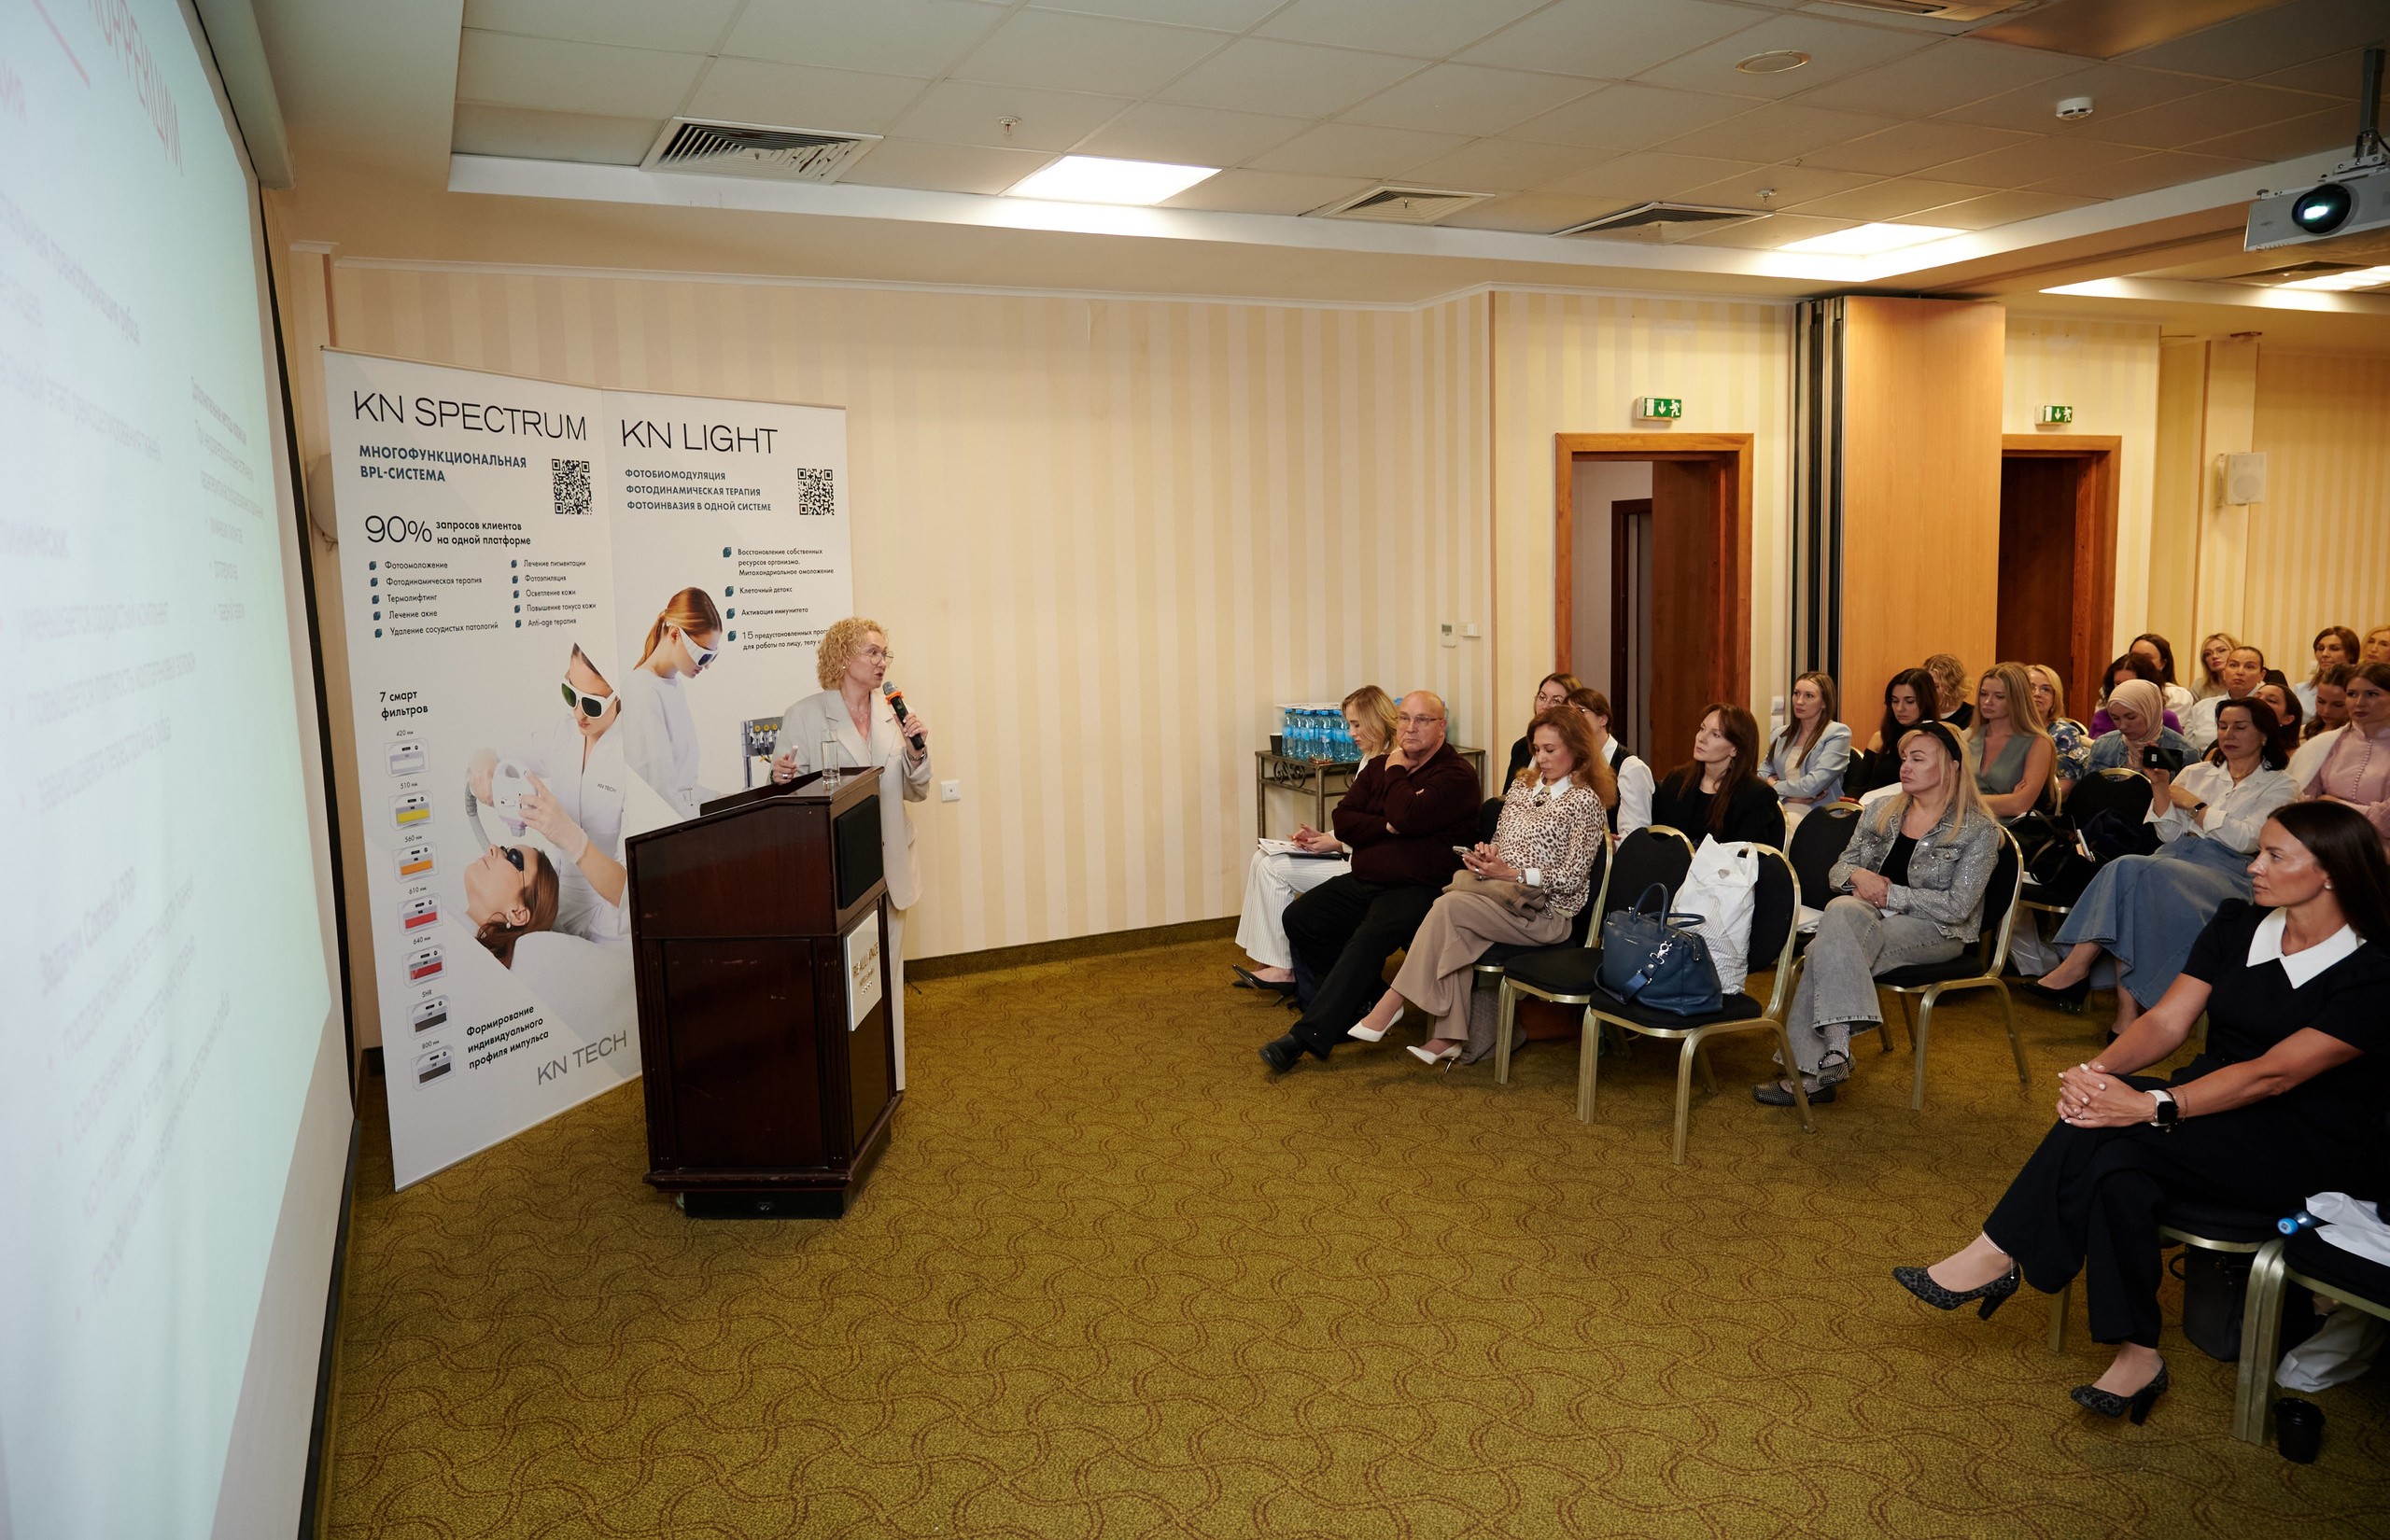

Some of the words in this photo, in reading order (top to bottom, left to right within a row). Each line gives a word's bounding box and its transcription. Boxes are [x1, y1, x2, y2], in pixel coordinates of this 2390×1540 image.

[353, 390, 404, 424] KN
[415, 397, 586, 441] SPECTRUM
[621, 419, 671, 449] KN
[683, 423, 778, 454] LIGHT
[359, 444, 527, 468] МНОГОФУНКЦИОНАЛЬНАЯ
[360, 465, 445, 482] BPL-СИСТЕМА
[625, 469, 725, 481] ФОТОБИОМОДУЛЯЦИЯ
[626, 484, 724, 496] ФОТОДИНАМИЧЕСКАЯ
[725, 487, 761, 496] ТЕРАПИЯ
[627, 501, 695, 511] ФОТОИНВАЗИЯ
[704, 501, 736, 511] ОДНОЙ
[365, 515, 432, 543] 90%
[435, 521, 480, 532] запросов
[482, 522, 522, 531] клиентов
[452, 535, 481, 546] одной
[483, 535, 531, 547] платформе
[386, 577, 455, 586] Фотодинамическая
[456, 578, 483, 586] терапия
[387, 593, 437, 604] Термолифтинг
[526, 589, 560, 597] Осветление
[388, 610, 419, 619] Лечение
[527, 619, 553, 627] Anti-age
[554, 618, 576, 626] терапия
[389, 626, 424, 636] Удаление
[425, 624, 464, 635] сосудистых
[465, 622, 499, 631] патологий
[742, 631, 753, 639] 15
[754, 630, 812, 640] предустановленных
[755, 642, 778, 651] работы
[380, 692, 386, 702] 7
[389, 692, 417, 702] смарт
[381, 706, 429, 721] фильтров
[409, 886, 419, 894] 610
[413, 936, 423, 945] 640
[422, 989, 432, 998] SHR
[466, 1006, 534, 1037] Формирование
[468, 1017, 543, 1054] индивидуального
[422, 1041, 432, 1049] 800
[469, 1048, 508, 1070] профиля
[510, 1030, 549, 1053] импульса
[537, 1056, 568, 1085] KN
[572, 1029, 626, 1068] TECH
